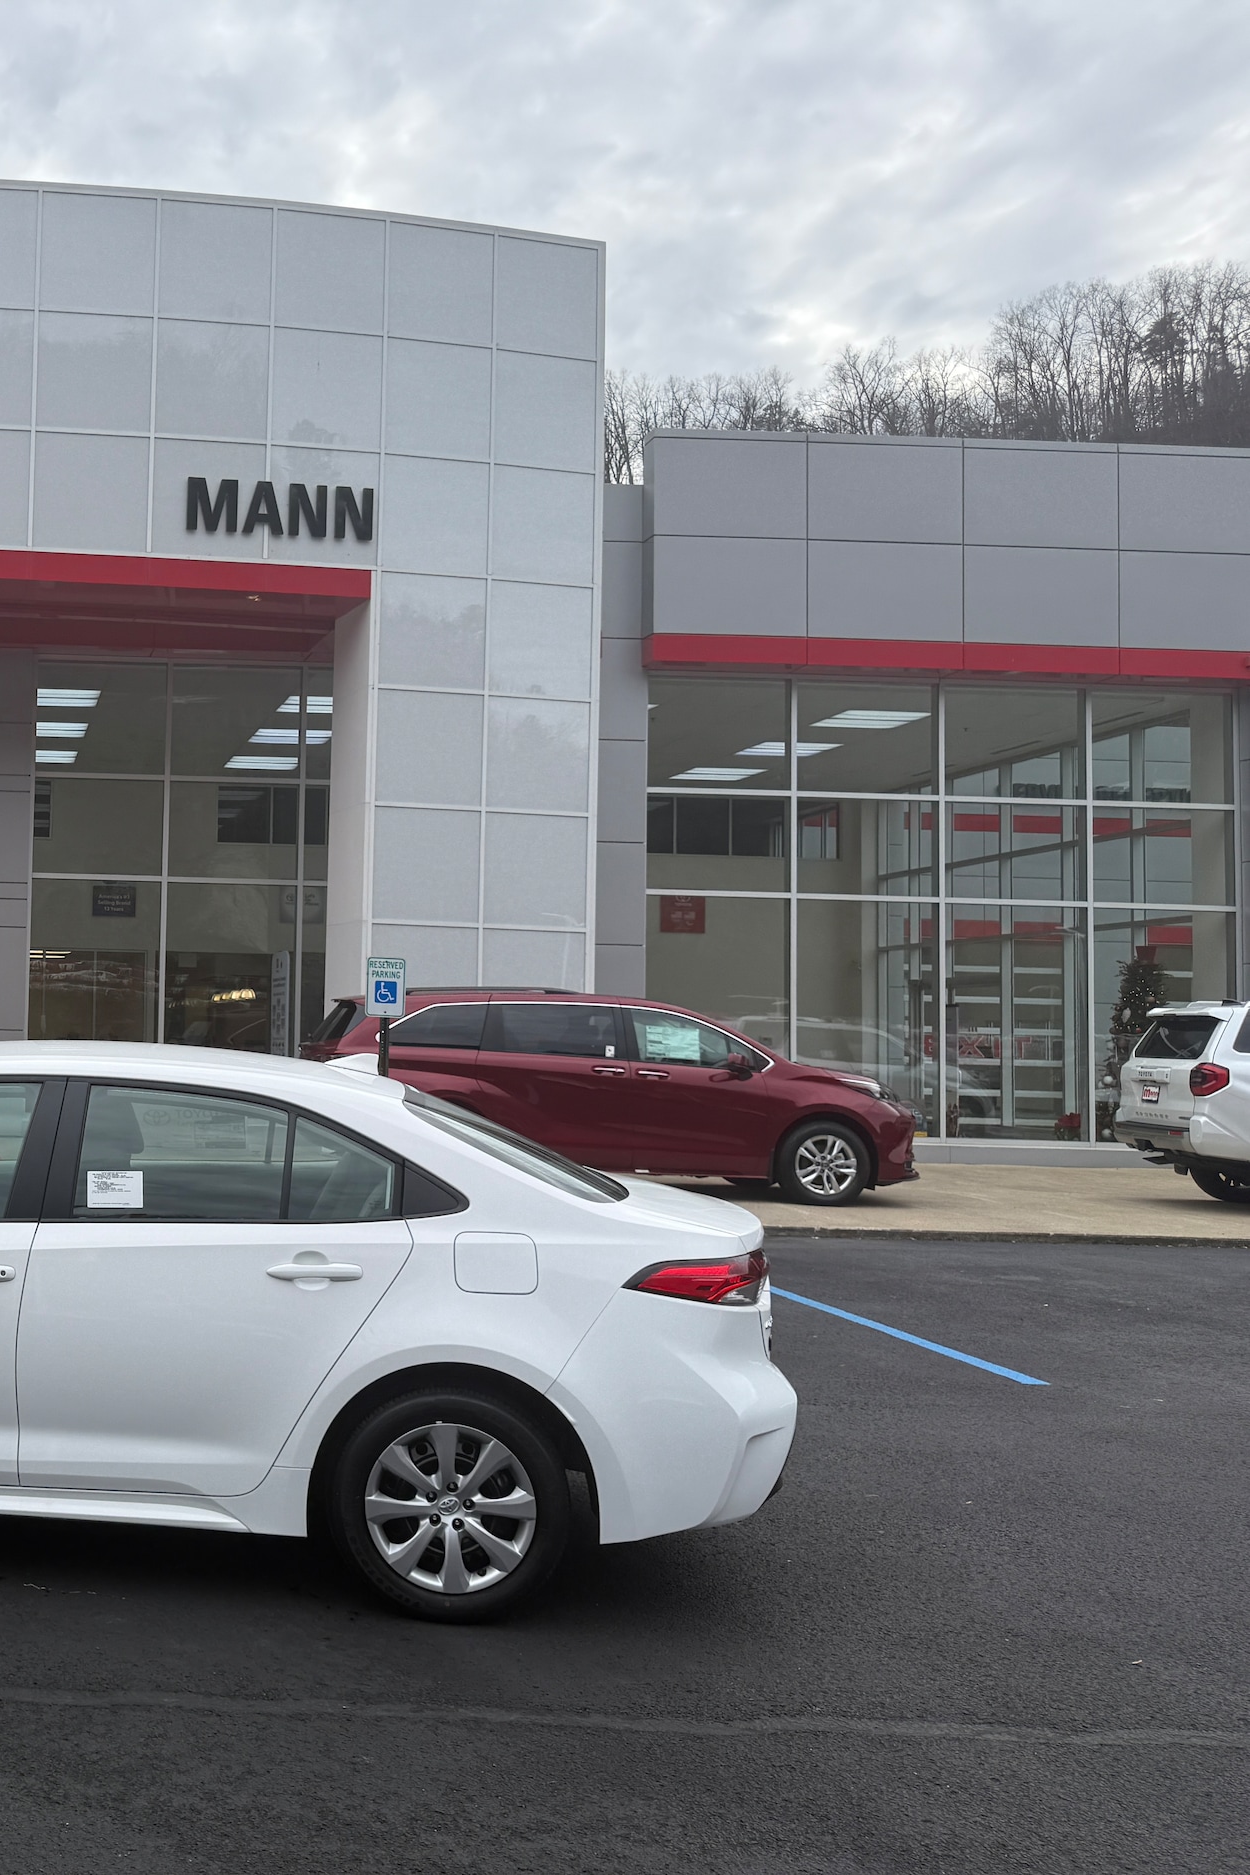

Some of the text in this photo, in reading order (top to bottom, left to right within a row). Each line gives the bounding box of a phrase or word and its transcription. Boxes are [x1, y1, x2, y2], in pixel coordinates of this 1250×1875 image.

[186, 476, 374, 541] MANN
[369, 961, 404, 970] RESERVED
[371, 970, 401, 979] PARKING
